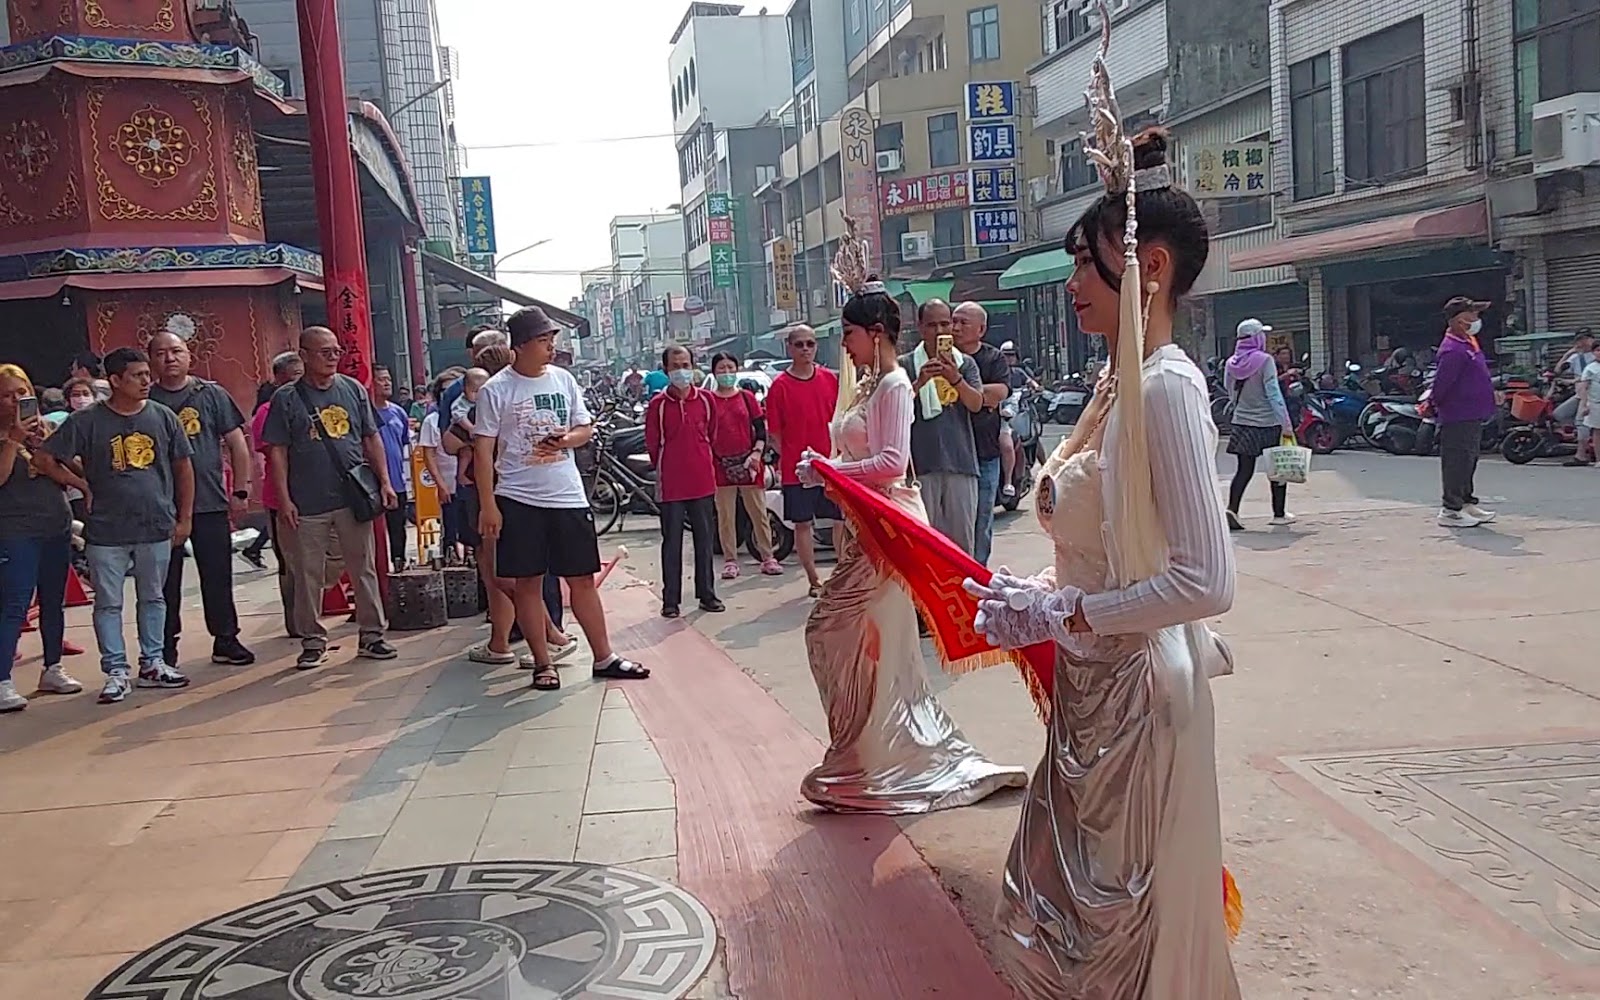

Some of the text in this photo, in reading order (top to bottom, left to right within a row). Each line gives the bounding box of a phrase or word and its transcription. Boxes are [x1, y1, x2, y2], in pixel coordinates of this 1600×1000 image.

[975, 85, 1008, 116] 鞋
[843, 111, 872, 166] 永川
[974, 127, 1012, 157] 釣具
[1222, 148, 1263, 168] 檳榔
[886, 180, 923, 207] 永川
[1223, 172, 1264, 191] 冷飲
